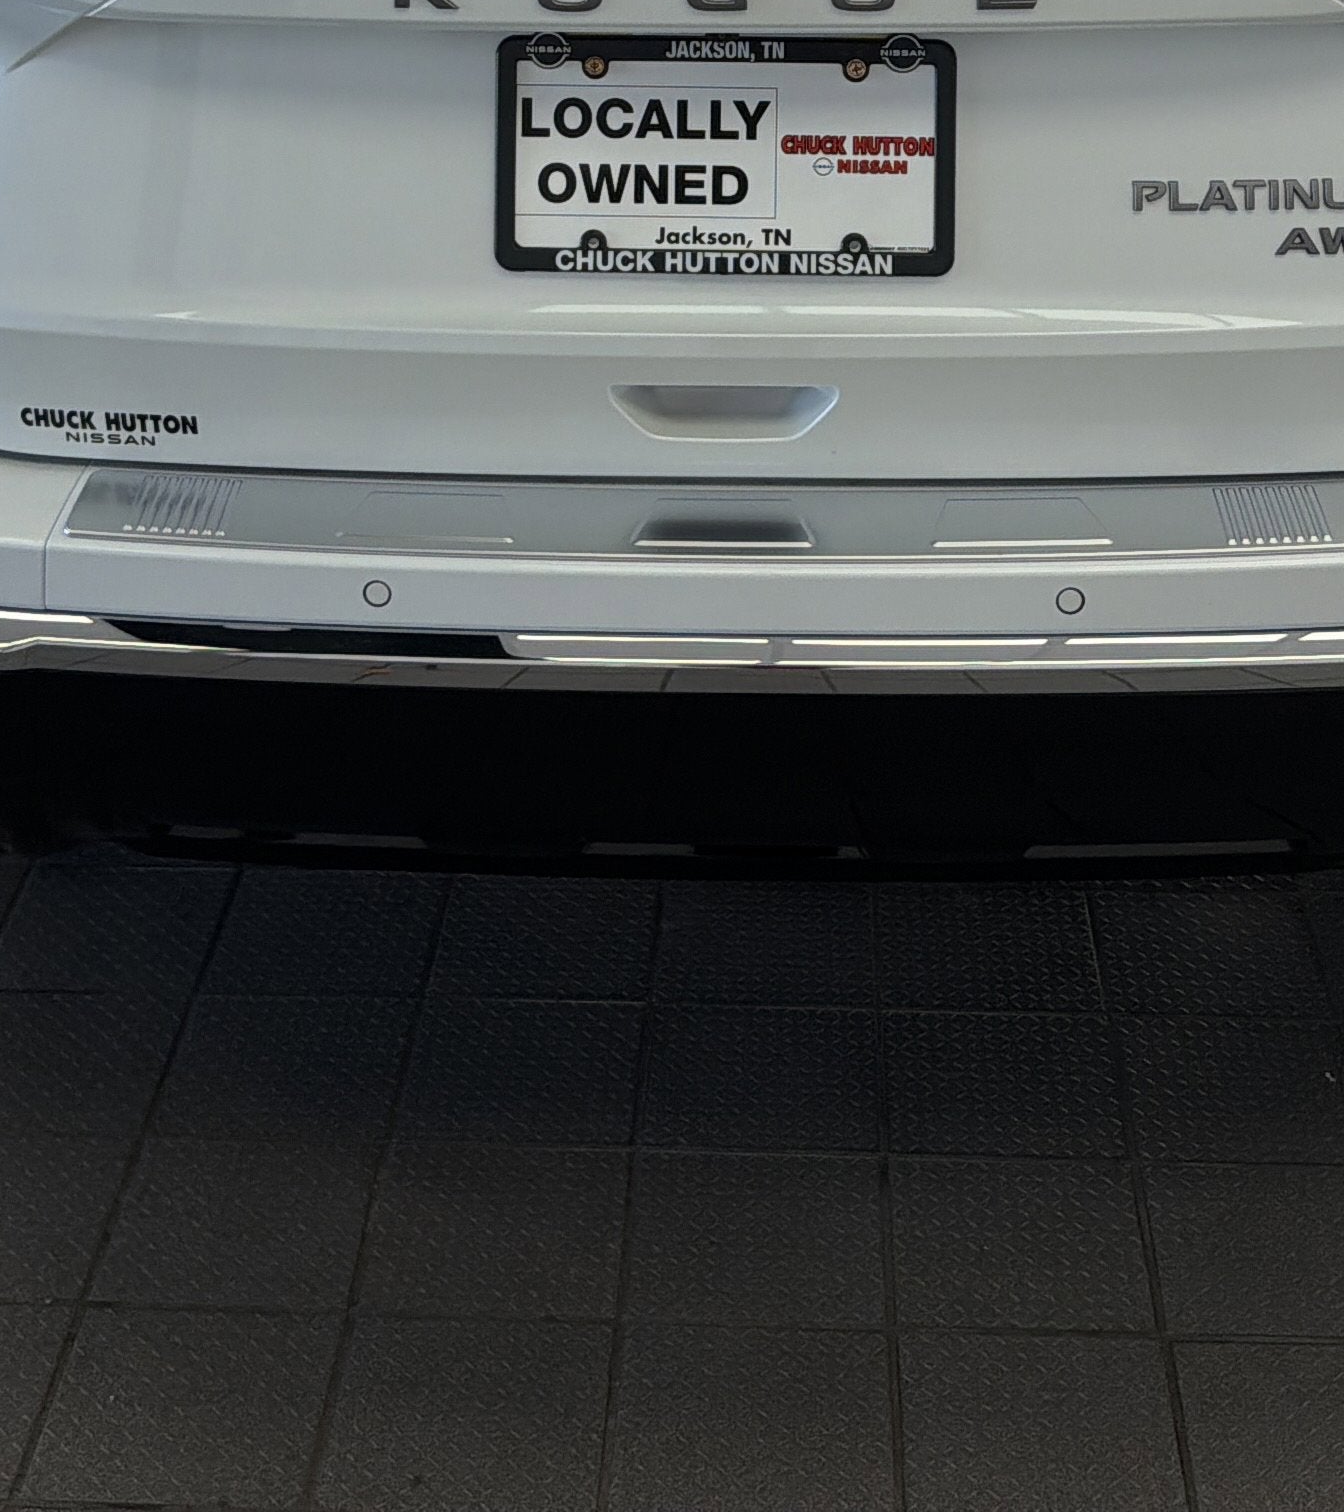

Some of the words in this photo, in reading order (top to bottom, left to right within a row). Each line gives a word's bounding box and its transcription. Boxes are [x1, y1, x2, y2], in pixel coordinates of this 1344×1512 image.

[526, 45, 572, 53] NISSAN
[665, 40, 757, 61] JACKSON,
[762, 41, 785, 60] TN
[880, 49, 926, 57] NISSAN
[521, 97, 772, 140] LOCALLY
[780, 135, 846, 155] CHUCK
[853, 136, 935, 157] HUTTON
[837, 159, 909, 175] NISSAN
[537, 162, 749, 206] OWNED
[655, 225, 755, 249] Jackson,
[762, 228, 792, 247] TN
[555, 250, 656, 273] CHUCK
[665, 251, 779, 274] HUTTON
[789, 253, 894, 276] NISSAN
[20, 407, 97, 431] CHUCK
[105, 412, 199, 435] HUTTON
[65, 431, 156, 447] NISSAN
